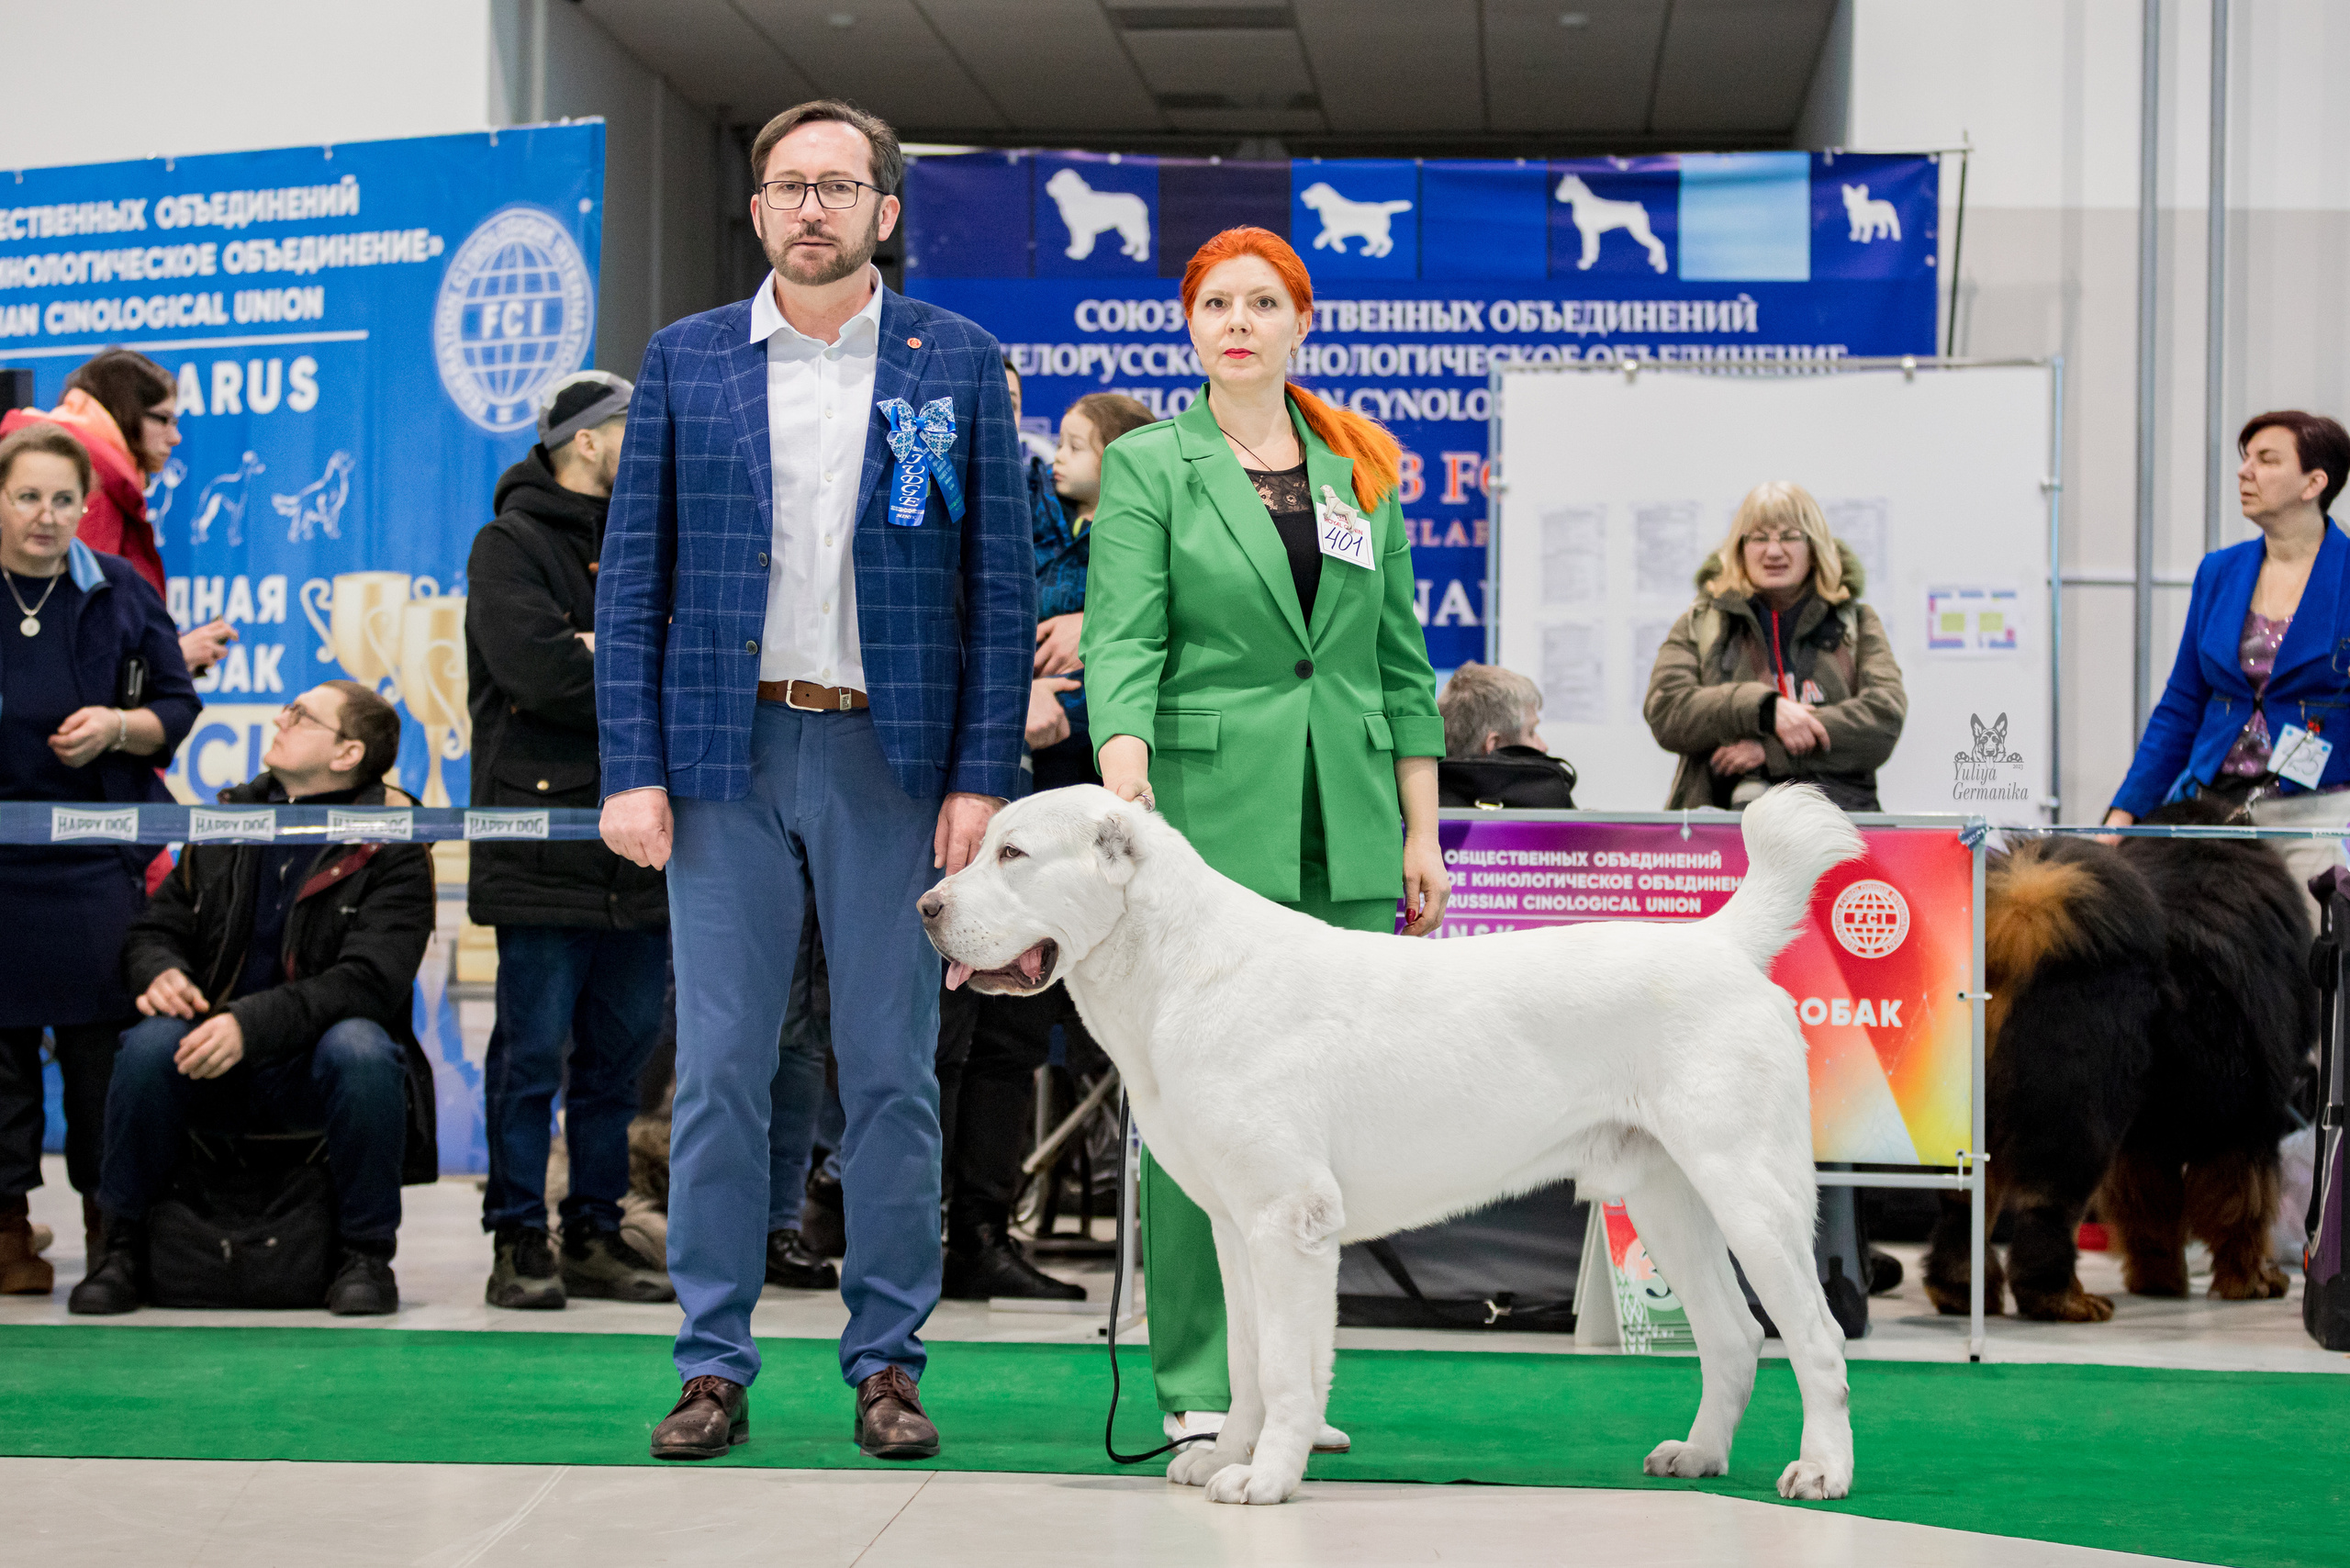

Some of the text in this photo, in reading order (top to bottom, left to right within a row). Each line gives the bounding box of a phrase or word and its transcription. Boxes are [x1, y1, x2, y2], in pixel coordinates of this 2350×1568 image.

[154, 174, 360, 230] ОБЪЕДИНЕНИЙ
[44, 291, 229, 335] CINOLOGICAL
[233, 285, 324, 324] UNION
[481, 300, 544, 340] FCI
[1074, 298, 1185, 332] СОЮЗ
[1488, 293, 1759, 338] ОБЪЕДИНЕНИЙ
[177, 354, 319, 416] ARUS
[1349, 387, 1496, 421] CYNOLO
[899, 454, 925, 507] JUDGE
[1325, 526, 1363, 557] 401
[165, 575, 287, 632] ДНАЯ
[57, 815, 132, 834] HAPPY DOG
[196, 816, 270, 834] HAPPY DOG
[469, 817, 543, 834] HAPPY DOG
[1444, 849, 1722, 870] ОБЩЕСТВЕННЫХ ОБЪЕДИНЕНИЙ
[1472, 872, 1633, 890] КИНОЛОГИЧЕСКОЕ
[1638, 875, 1744, 893] ОБЪЕДИНЕН
[1448, 893, 1702, 913] RUSSIAN CINOLOGICAL UNION
[1854, 913, 1886, 924] FCI
[1800, 997, 1903, 1027] ОБАК
